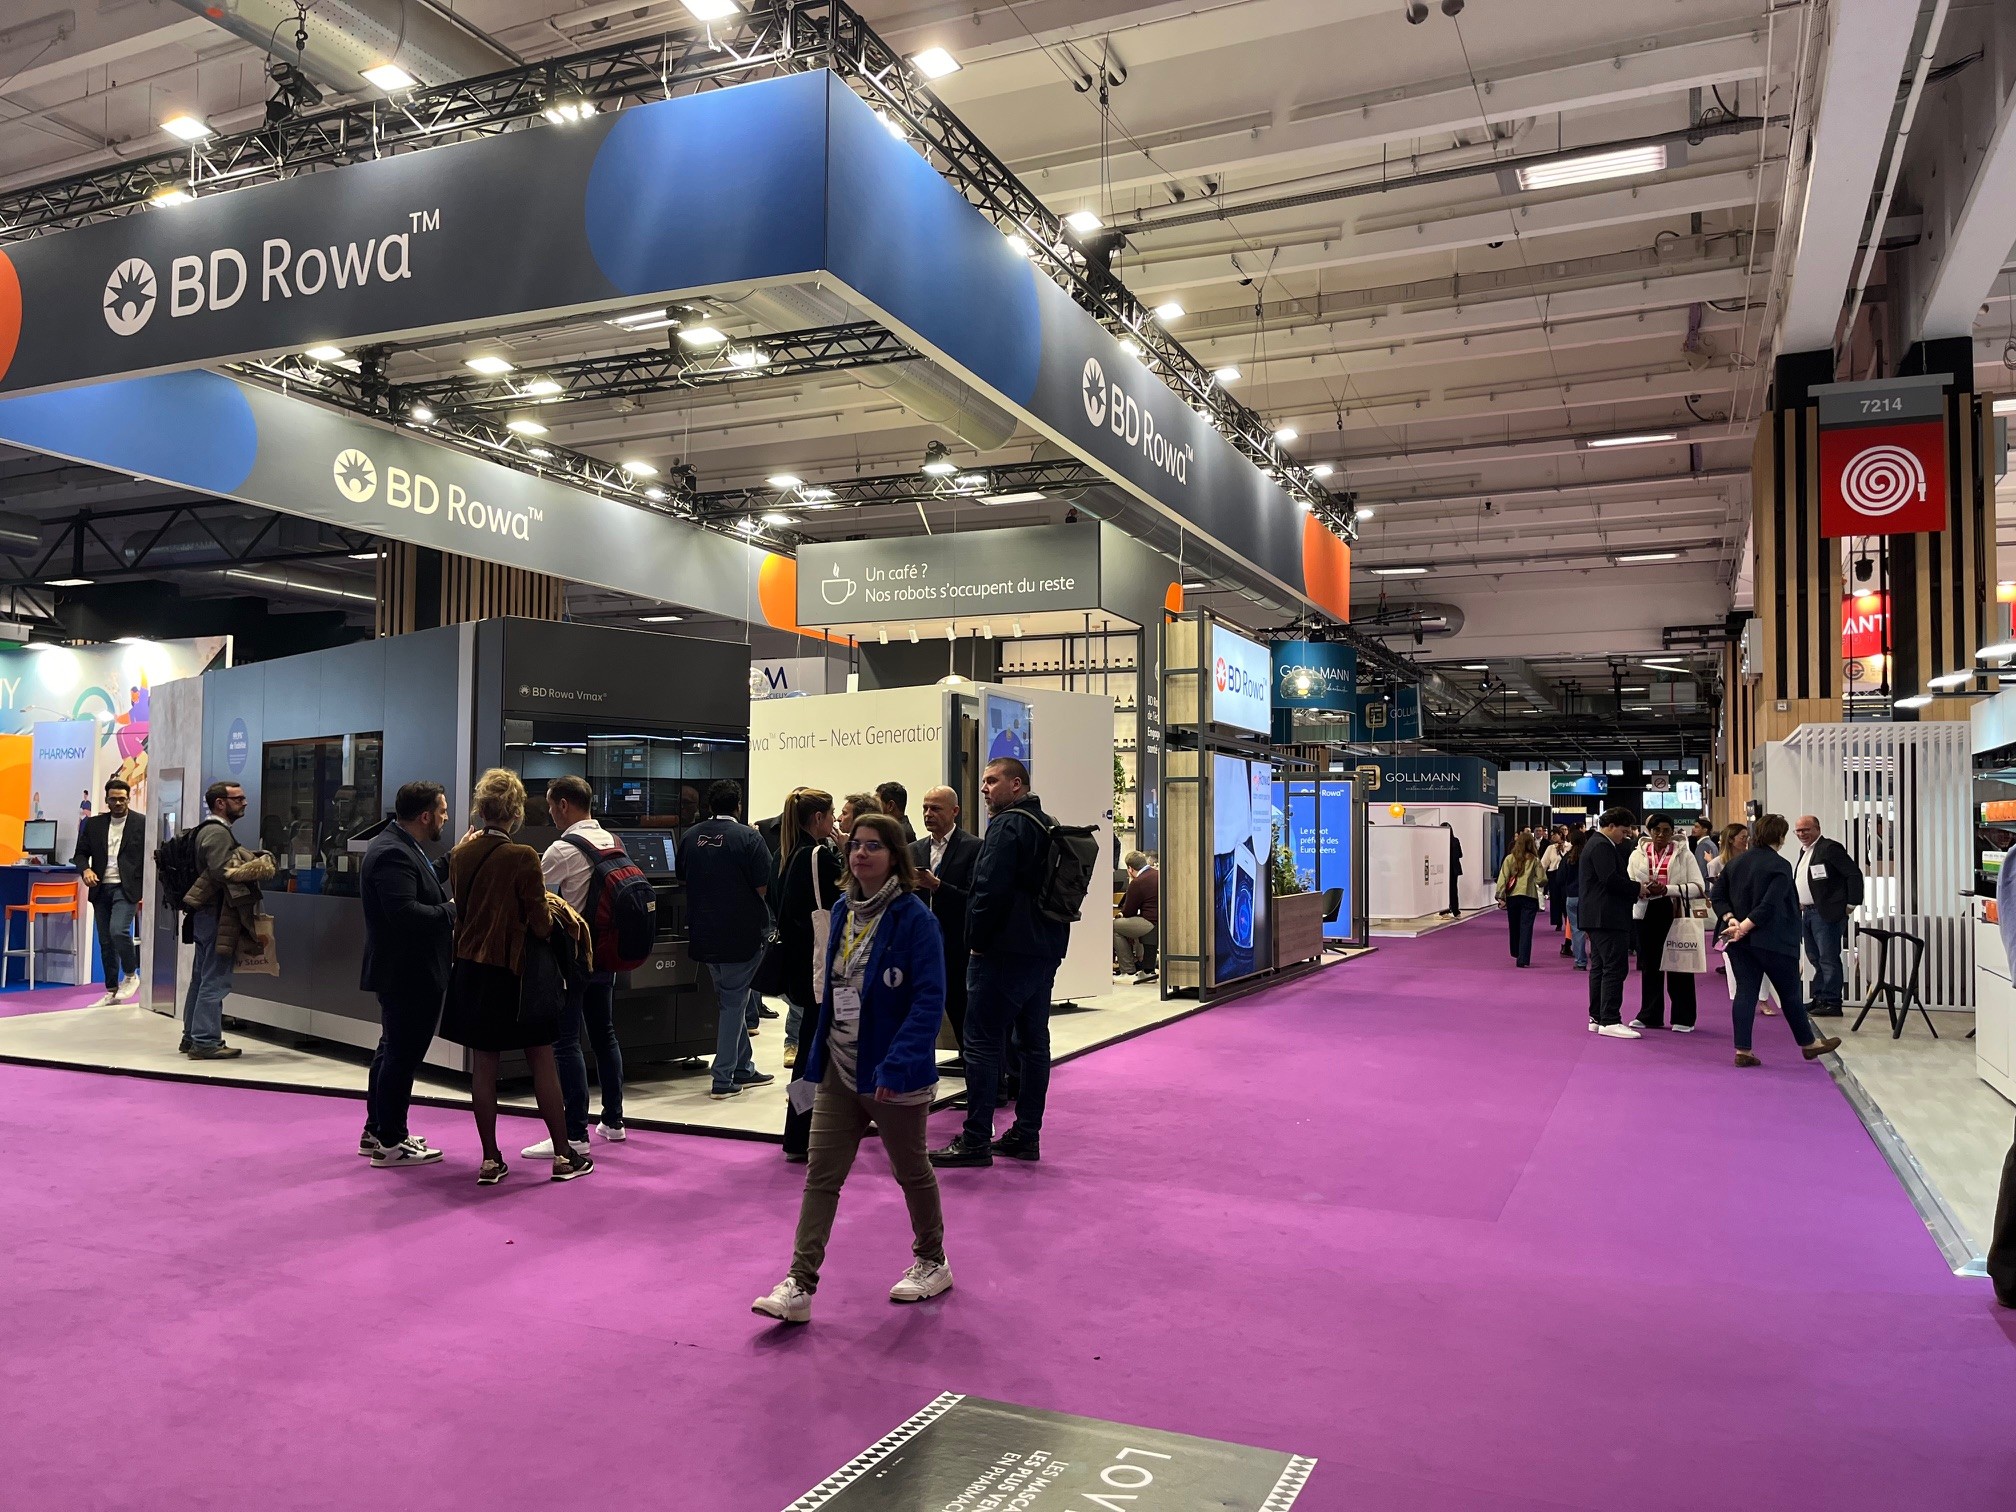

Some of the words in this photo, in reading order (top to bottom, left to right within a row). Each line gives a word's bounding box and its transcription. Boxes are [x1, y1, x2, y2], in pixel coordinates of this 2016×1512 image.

[170, 248, 248, 318] BD
[1111, 382, 1140, 447] BD
[1860, 397, 1903, 414] 7214
[387, 466, 440, 515] BD
[865, 566, 885, 582] Un
[888, 564, 918, 580] café
[921, 563, 928, 578] ?
[865, 588, 891, 602] Nos
[894, 585, 937, 601] robots
[940, 582, 1014, 599] s'occupent
[1017, 577, 1035, 593] du
[1039, 576, 1075, 592] reste
[1228, 664, 1241, 693] BD
[1280, 664, 1350, 682] GOLLMANN
[0, 677, 21, 710] Y
[532, 686, 547, 697] BD
[549, 688, 574, 699] Rowa
[779, 732, 816, 750] Smart
[831, 728, 862, 747] Next
[39, 747, 87, 760] PHARMONY
[1385, 772, 1461, 783] GOLLMANN
[1300, 827, 1309, 835] Le
[1326, 836, 1339, 845] des
[1300, 846, 1337, 854] Euroéens
[244, 956, 269, 966] Stock
[665, 960, 676, 968] BD
[996, 1451, 1022, 1467] EN
[1023, 1449, 1052, 1468] LES
[1041, 1460, 1070, 1478] LES
[941, 1465, 1006, 1512] PHARMAC
[997, 1466, 1034, 1493] PLUS
[1065, 1447, 1173, 1512] LOV
[1002, 1476, 1052, 1512] MASCA
